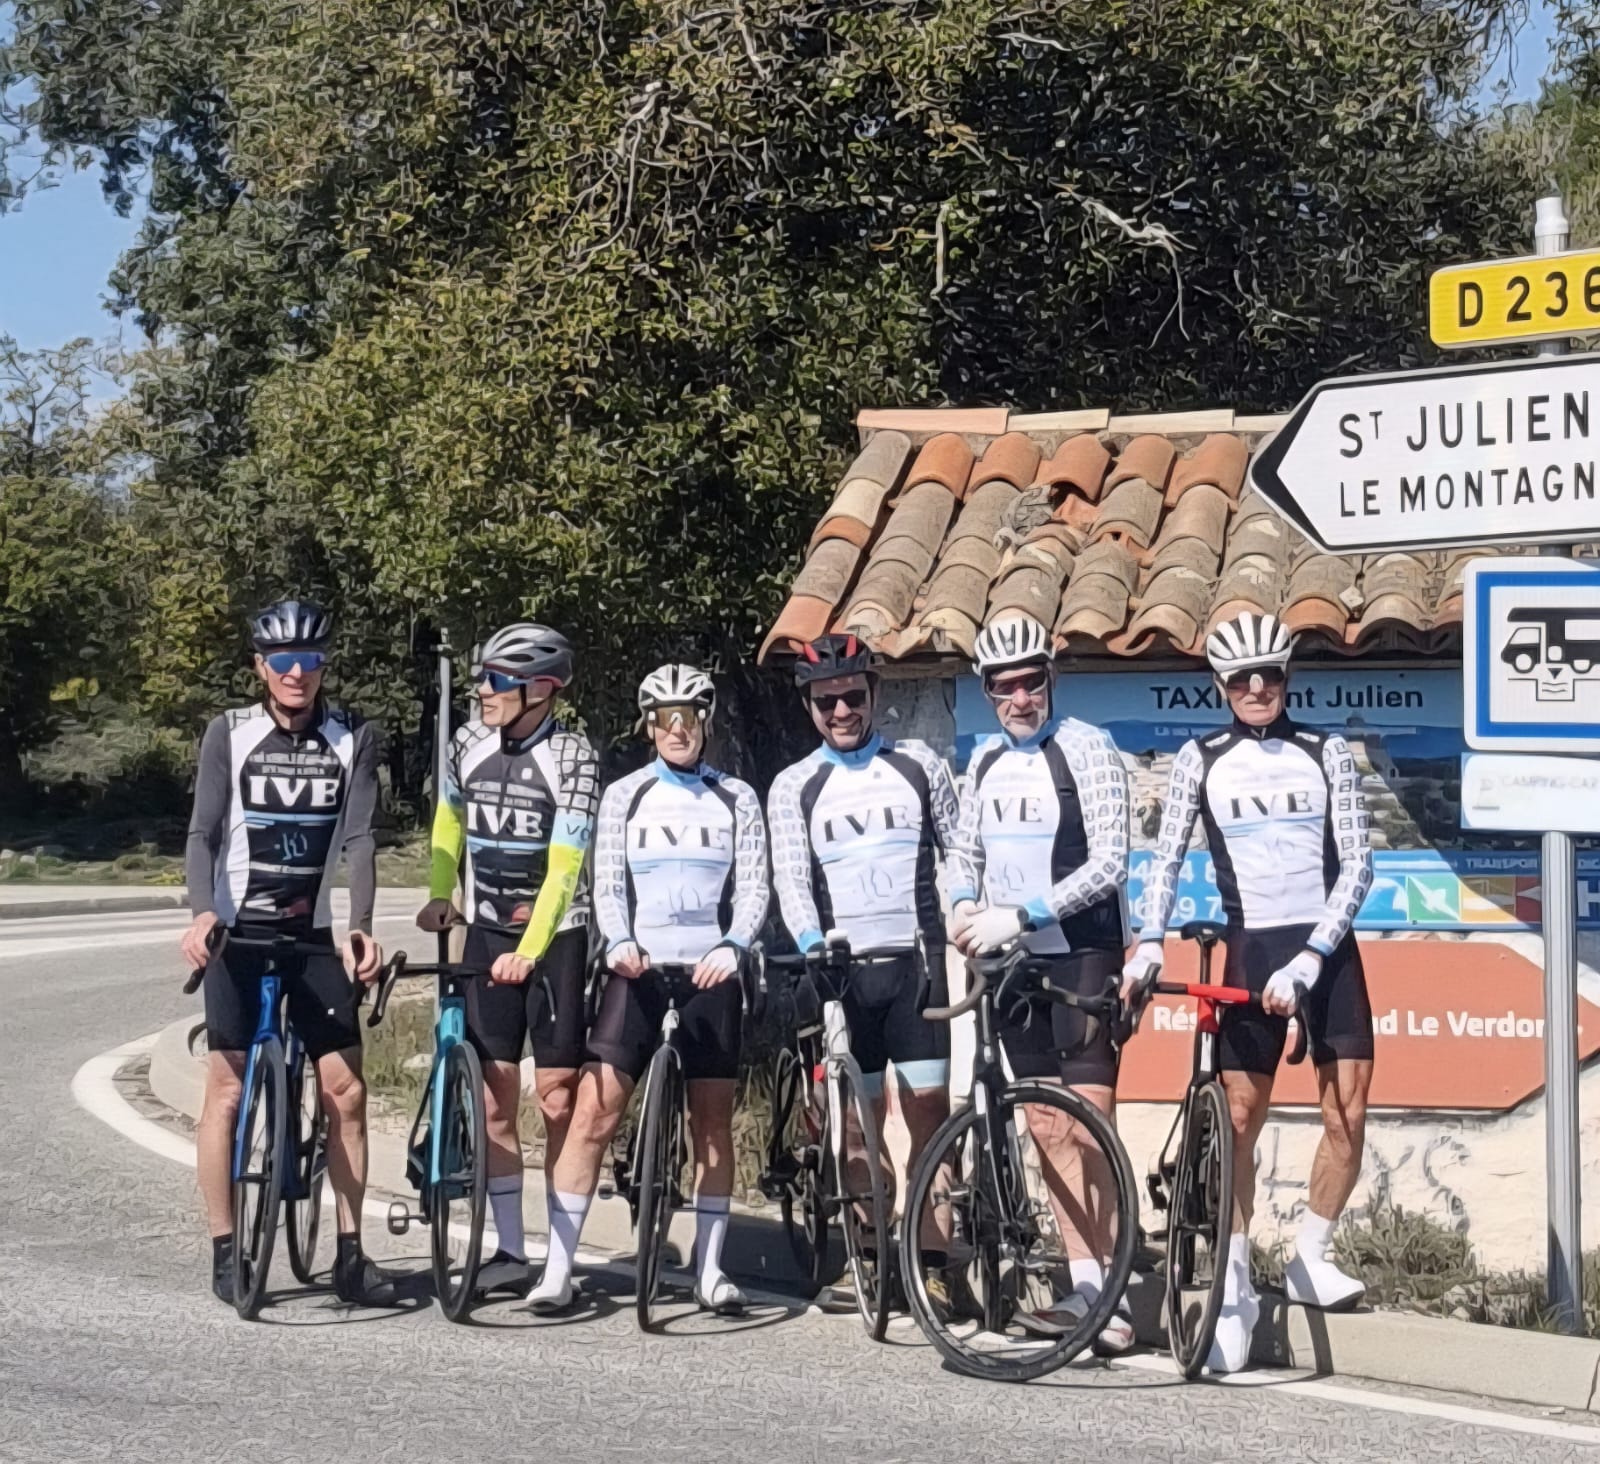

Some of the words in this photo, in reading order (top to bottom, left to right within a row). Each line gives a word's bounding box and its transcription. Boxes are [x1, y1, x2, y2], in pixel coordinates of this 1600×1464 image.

[1459, 282, 1483, 327] D
[1506, 266, 1600, 323] 236
[1406, 391, 1589, 451] JULIEN
[1340, 480, 1380, 517] LE
[1400, 461, 1594, 513] MONTAGN
[1150, 686, 1222, 709] TAXI
[1326, 686, 1423, 709] Julien
[991, 797, 1043, 824] VE
[1407, 1010, 1439, 1036] Le
